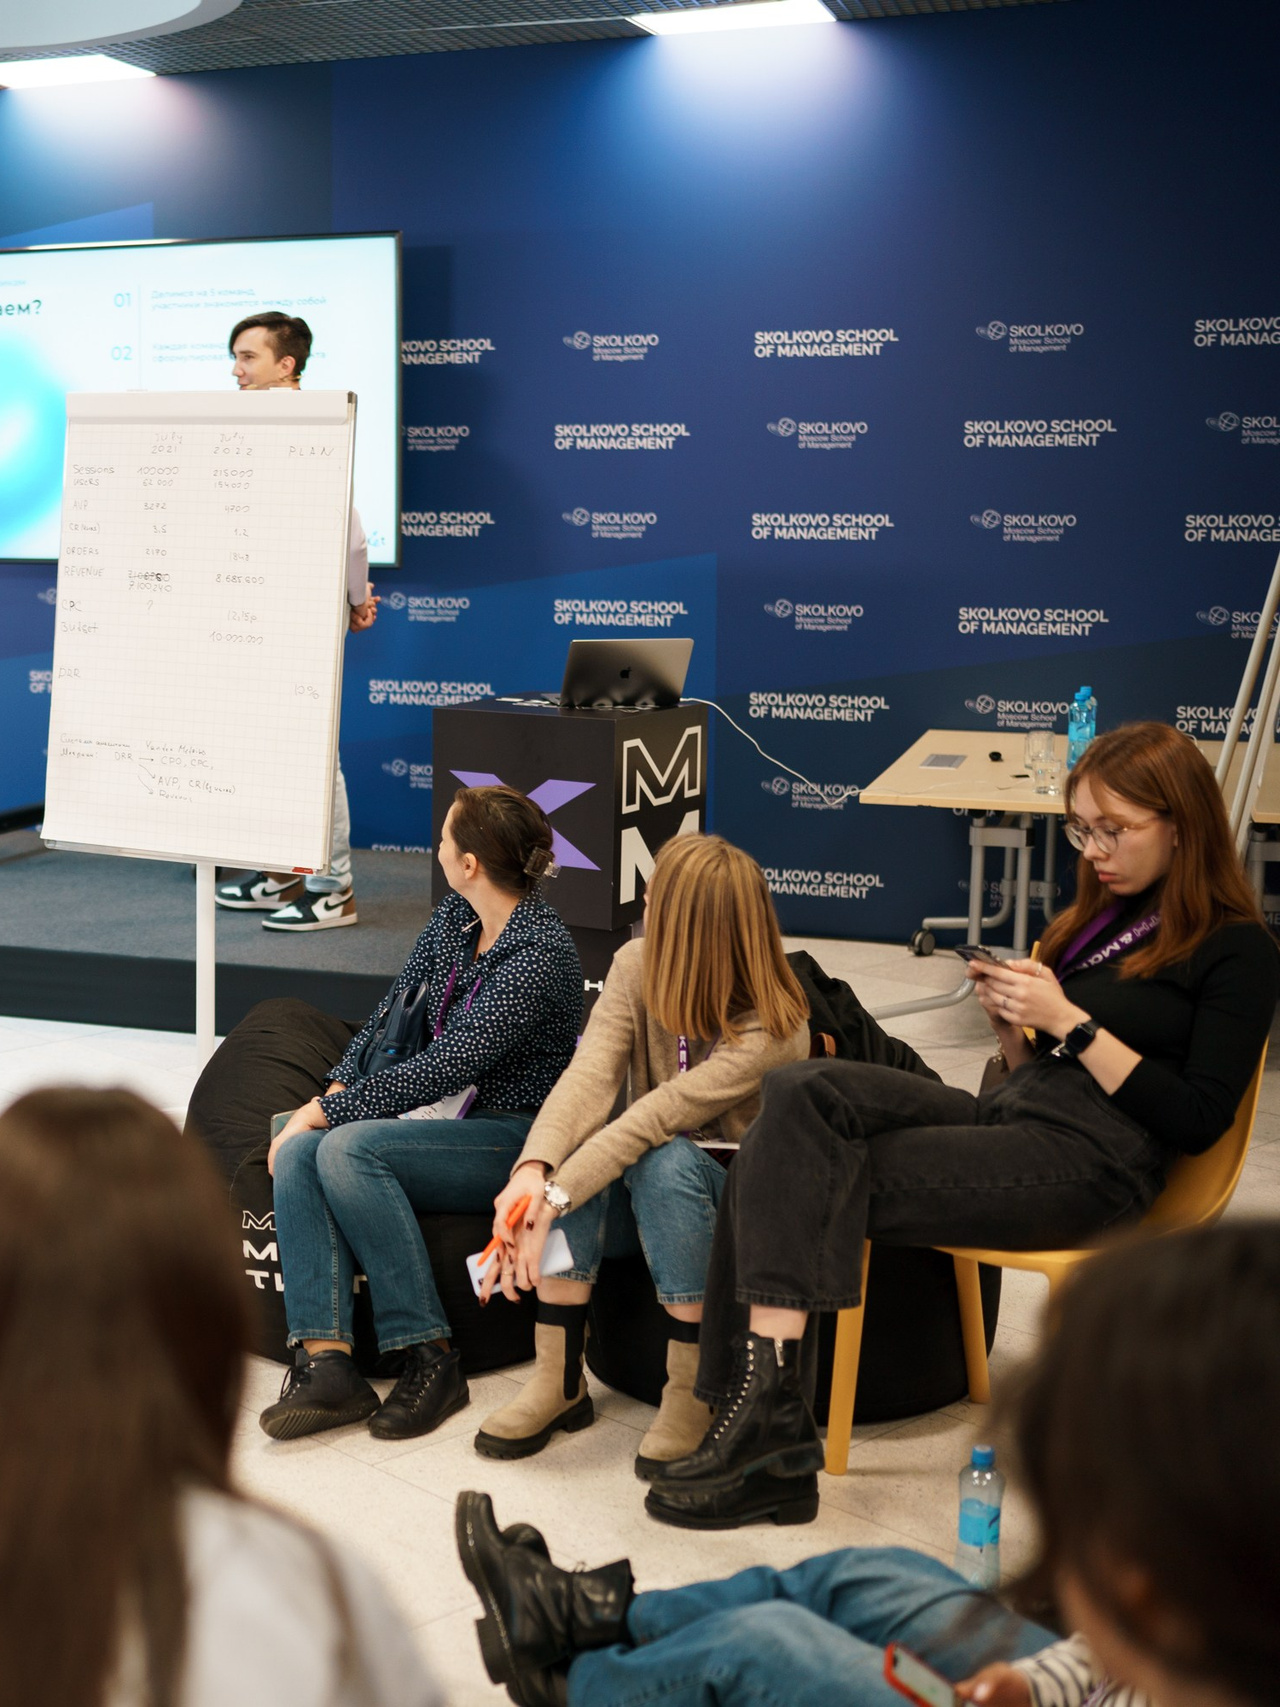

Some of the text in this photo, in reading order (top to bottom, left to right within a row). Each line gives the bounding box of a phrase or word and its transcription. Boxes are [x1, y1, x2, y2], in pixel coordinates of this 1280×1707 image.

[114, 293, 131, 307] 01
[754, 328, 898, 344] SKOLKOVO SCHOOL
[1009, 324, 1084, 337] SKOLKOVO
[402, 338, 495, 353] KOVO SCHOOL
[593, 334, 659, 346] SKOLKOVO
[1194, 334, 1217, 347] OF
[111, 346, 132, 360] 02
[754, 343, 882, 358] OF MANAGEMENT
[408, 426, 469, 437] SKOLKOVO
[555, 424, 690, 436] SKOLKOVO SCHOOL
[798, 422, 868, 433] SKOLKOVO
[964, 420, 1116, 433] SKOLKOVO SCHOOL
[555, 438, 675, 449] OF MANAGEMENT
[964, 434, 1099, 447] OF MANAGEMENT
[151, 445, 178, 455] 2021
[289, 445, 334, 457] PLAN
[144, 502, 167, 511] 3272
[224, 504, 251, 514] 4700
[402, 512, 495, 523] KOVO SCHOOL
[592, 513, 657, 524] SKOLKOVO
[752, 514, 894, 526] SKOLKOVO SCHOOL
[1003, 515, 1076, 526] SKOLKOVO
[1185, 515, 1274, 528] SKOLKOVO
[752, 528, 878, 540] OF MANAGEMENT
[1184, 529, 1207, 542] OF
[64, 566, 104, 578] REVENUE
[408, 597, 470, 608] SKOLKOVO
[554, 599, 688, 614] SKOLKOVO SCHOOL
[795, 604, 863, 616] SKOLKOVO
[958, 607, 1109, 622] SKOLKOVO SCHOOL
[554, 613, 673, 627] OF MANAGEMENT
[958, 622, 1092, 636] OF MANAGEMENT
[369, 680, 495, 694] SKOLKOVO SCHOOL
[369, 693, 386, 704] OF
[749, 692, 889, 709] SKOLKOVO SCHOOL
[997, 700, 1070, 714] SKOLKOVO
[749, 706, 873, 722] OF MANAGEMENT
[1176, 720, 1198, 732] OF
[622, 725, 702, 814] M
[762, 868, 884, 888] OLKOVO SCHOOL
[768, 882, 869, 899] MANAGEMENT
